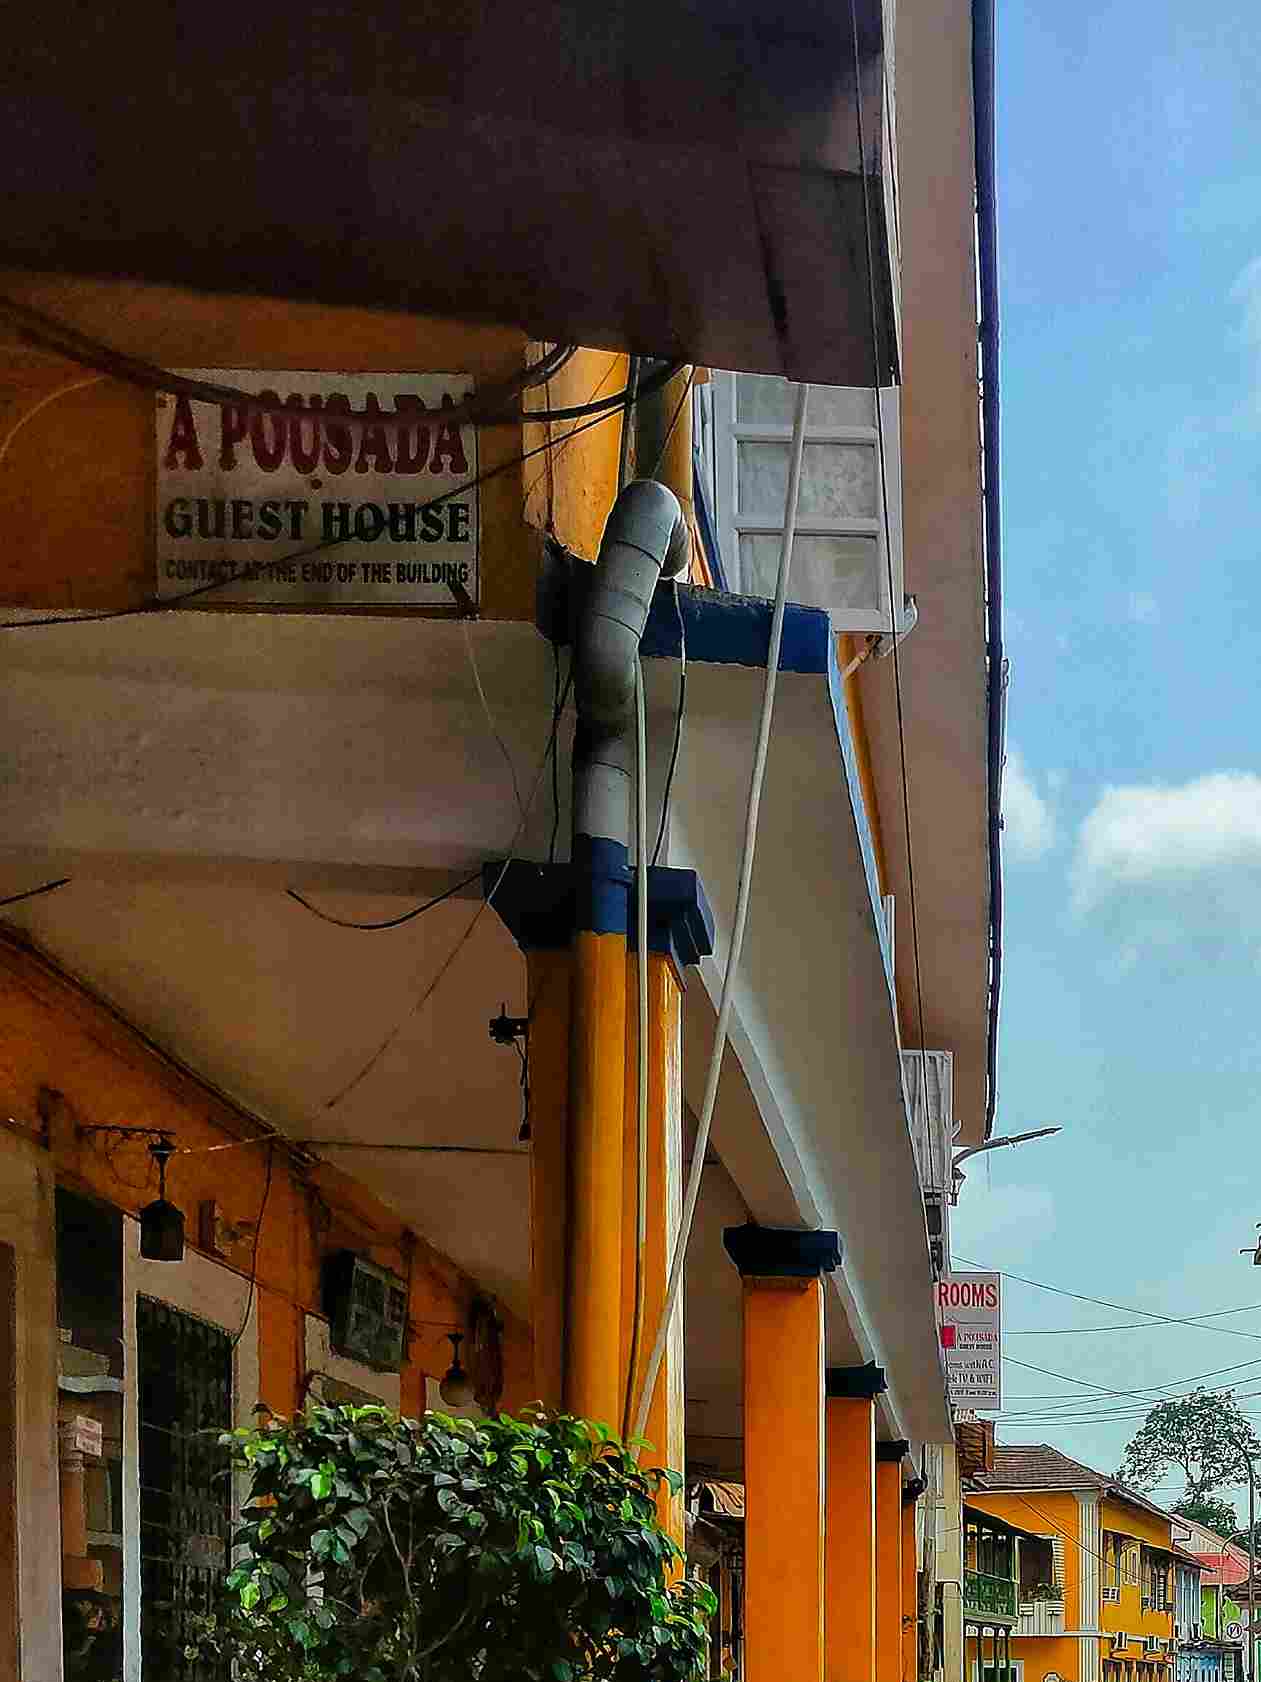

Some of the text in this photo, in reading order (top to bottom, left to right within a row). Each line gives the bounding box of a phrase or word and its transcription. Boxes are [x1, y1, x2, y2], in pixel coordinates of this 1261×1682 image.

[164, 389, 470, 474] A POUSADA
[165, 497, 470, 543] GUEST HOUSE
[302, 561, 337, 583] END
[339, 562, 358, 583] OF
[362, 562, 391, 584] THE
[396, 562, 469, 585] BUILDING
[938, 1282, 998, 1308] ROOMS
